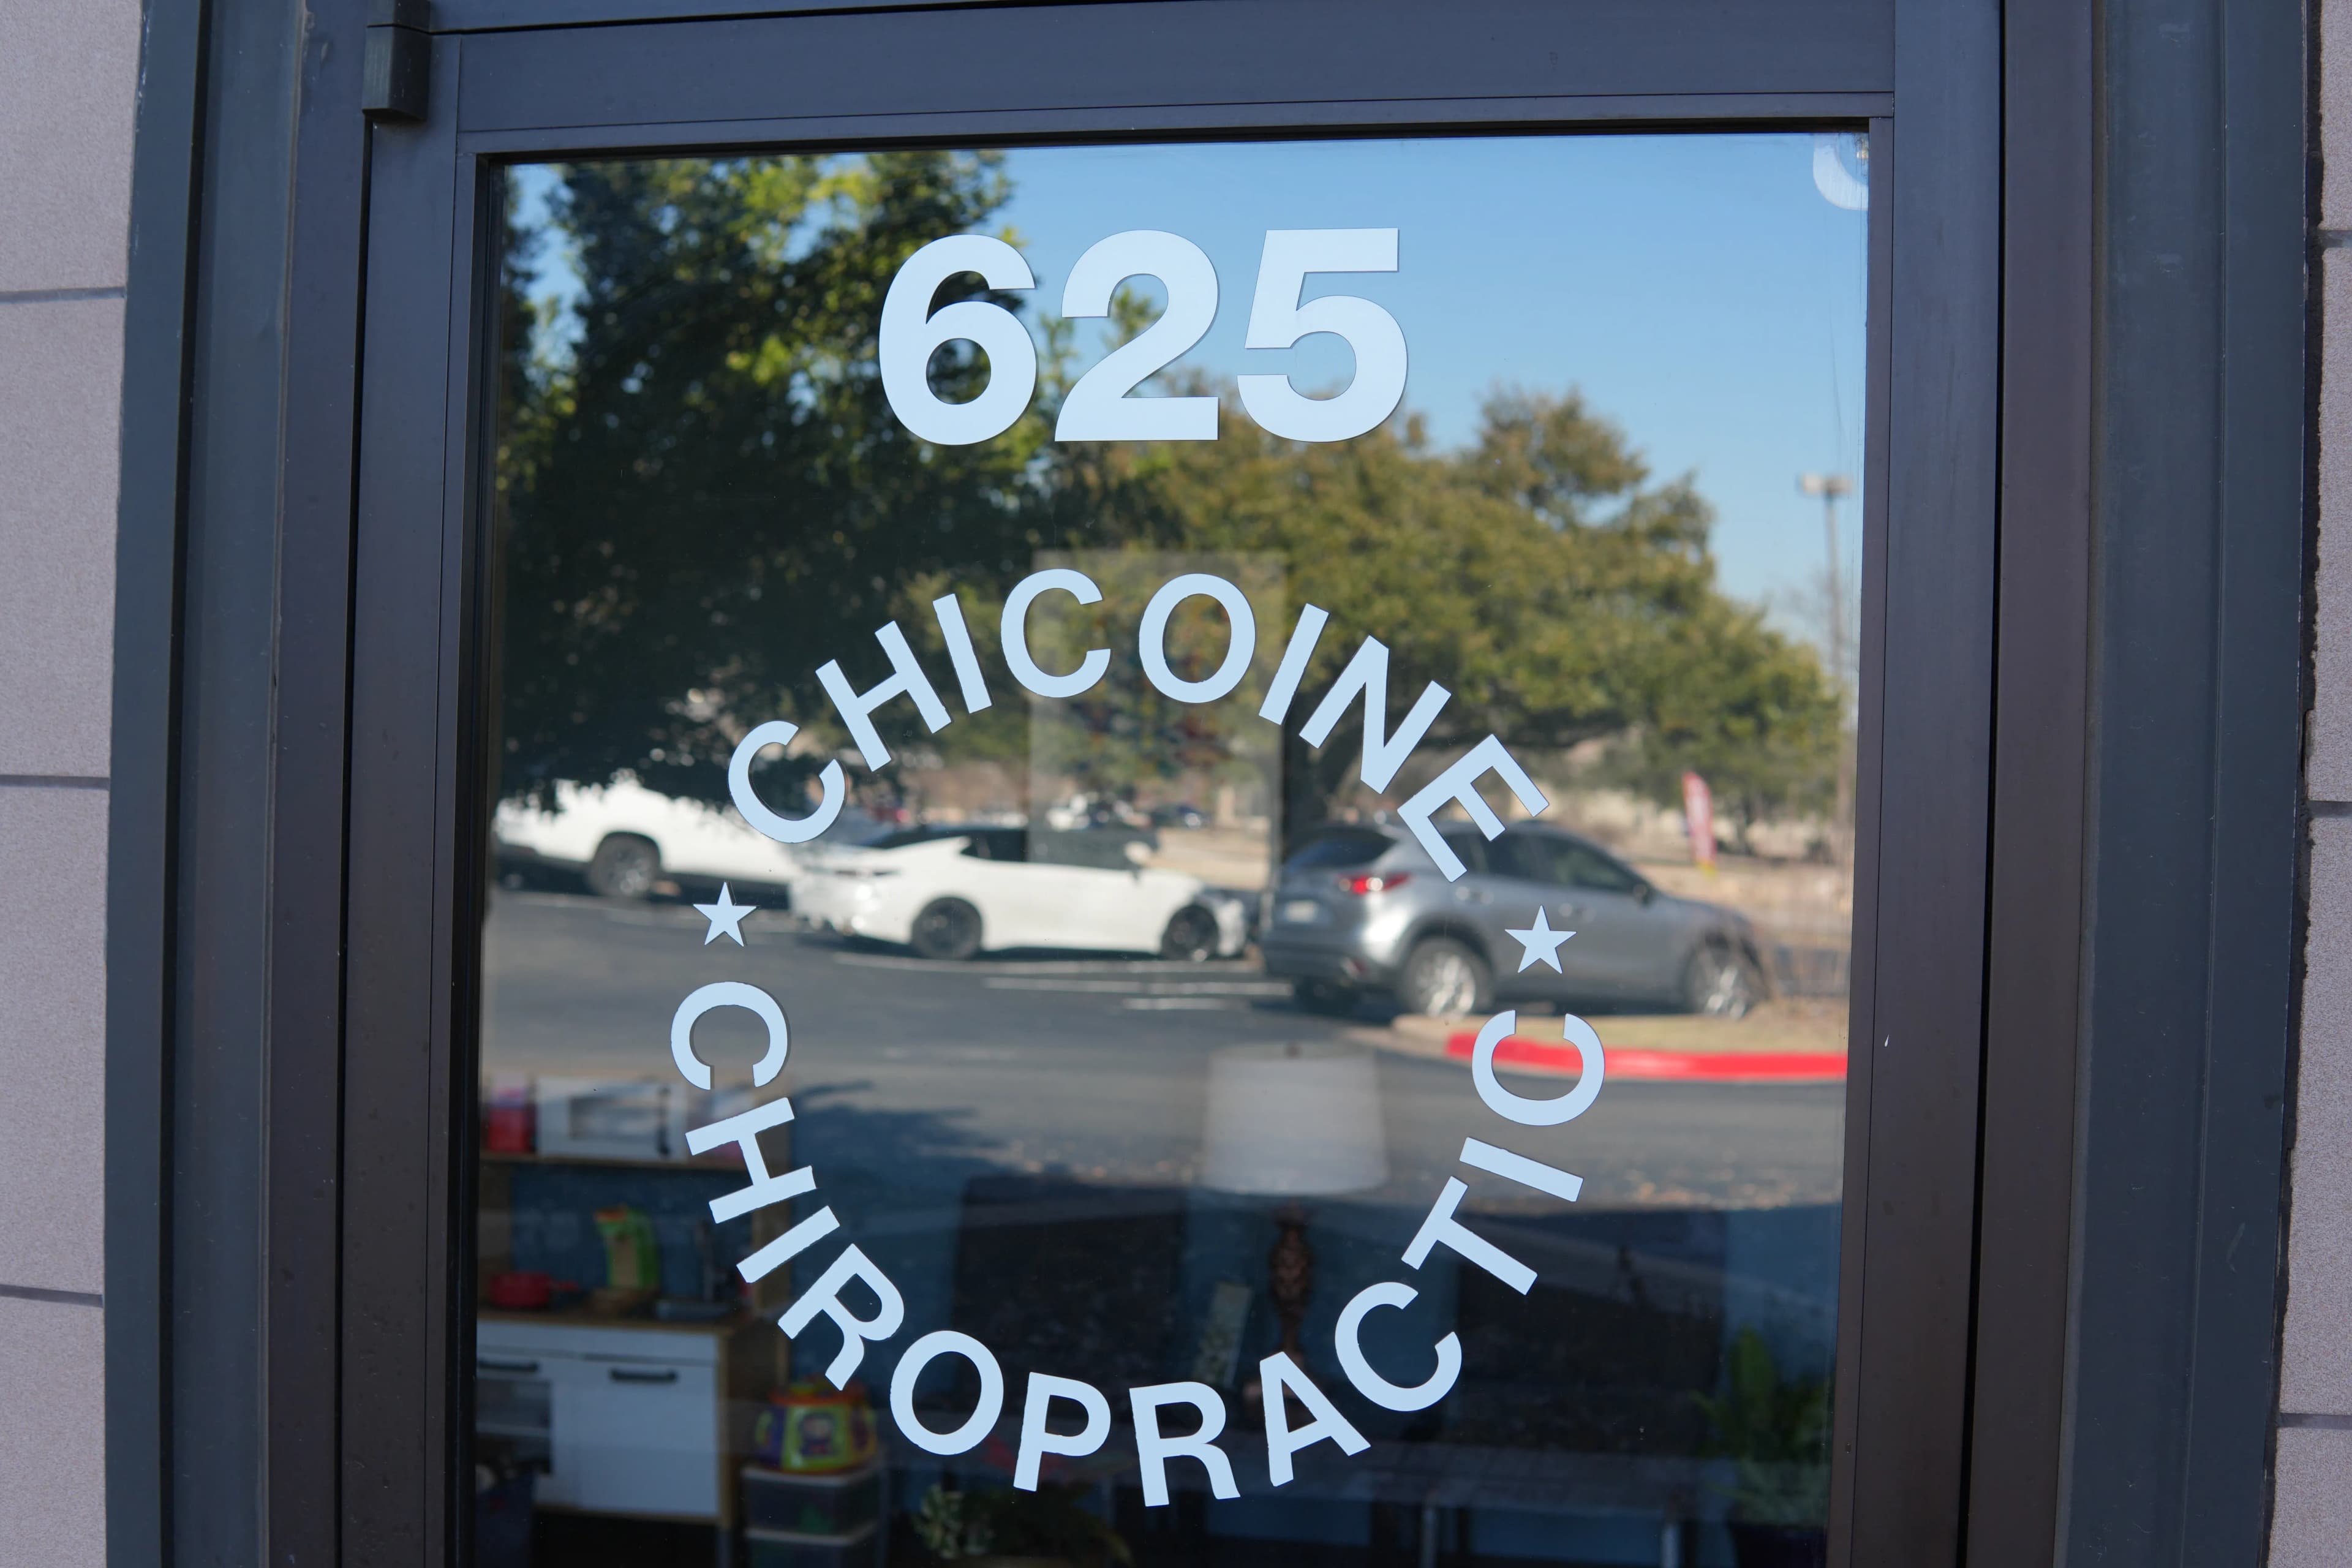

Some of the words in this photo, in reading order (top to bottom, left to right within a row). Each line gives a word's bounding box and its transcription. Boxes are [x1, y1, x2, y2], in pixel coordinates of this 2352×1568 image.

[878, 227, 1408, 446] 625
[728, 568, 1550, 883] CHICOINE
[670, 981, 1605, 1507] CHIROPRACTIC
